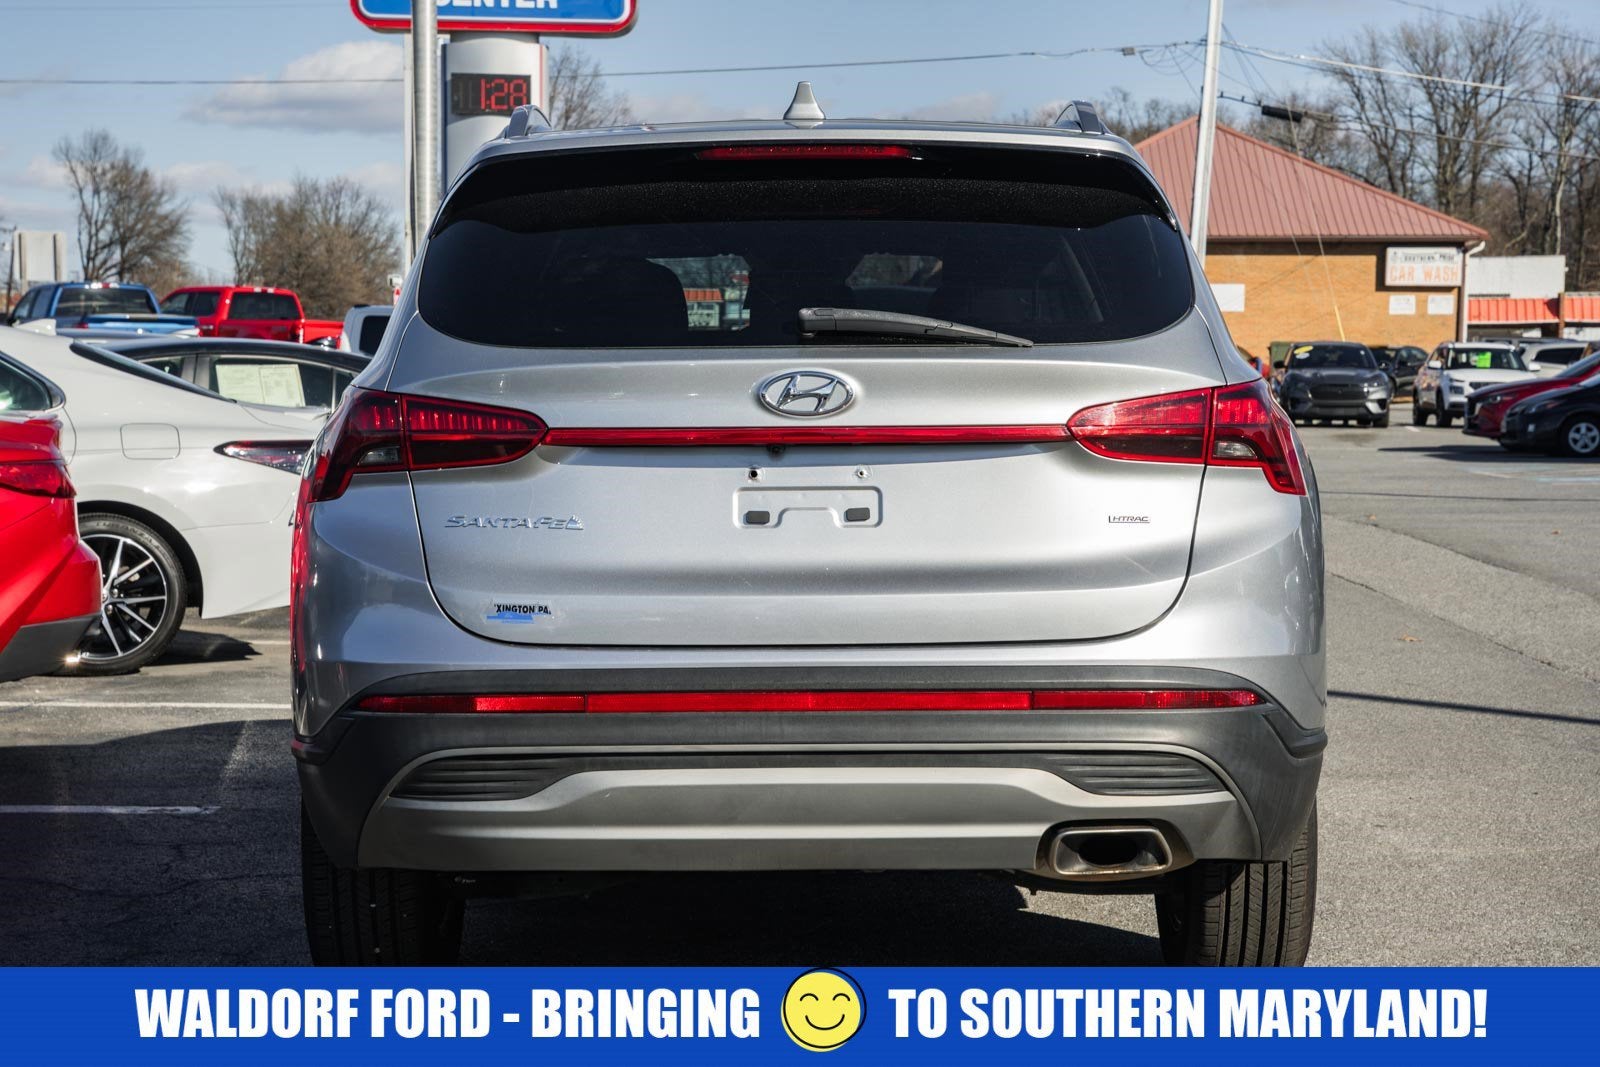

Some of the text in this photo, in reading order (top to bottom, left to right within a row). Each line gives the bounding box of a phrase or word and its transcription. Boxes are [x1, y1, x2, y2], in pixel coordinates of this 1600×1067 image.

[480, 79, 527, 110] 1:28
[1390, 264, 1459, 281] CAR WASH
[494, 603, 535, 614] XINGTON
